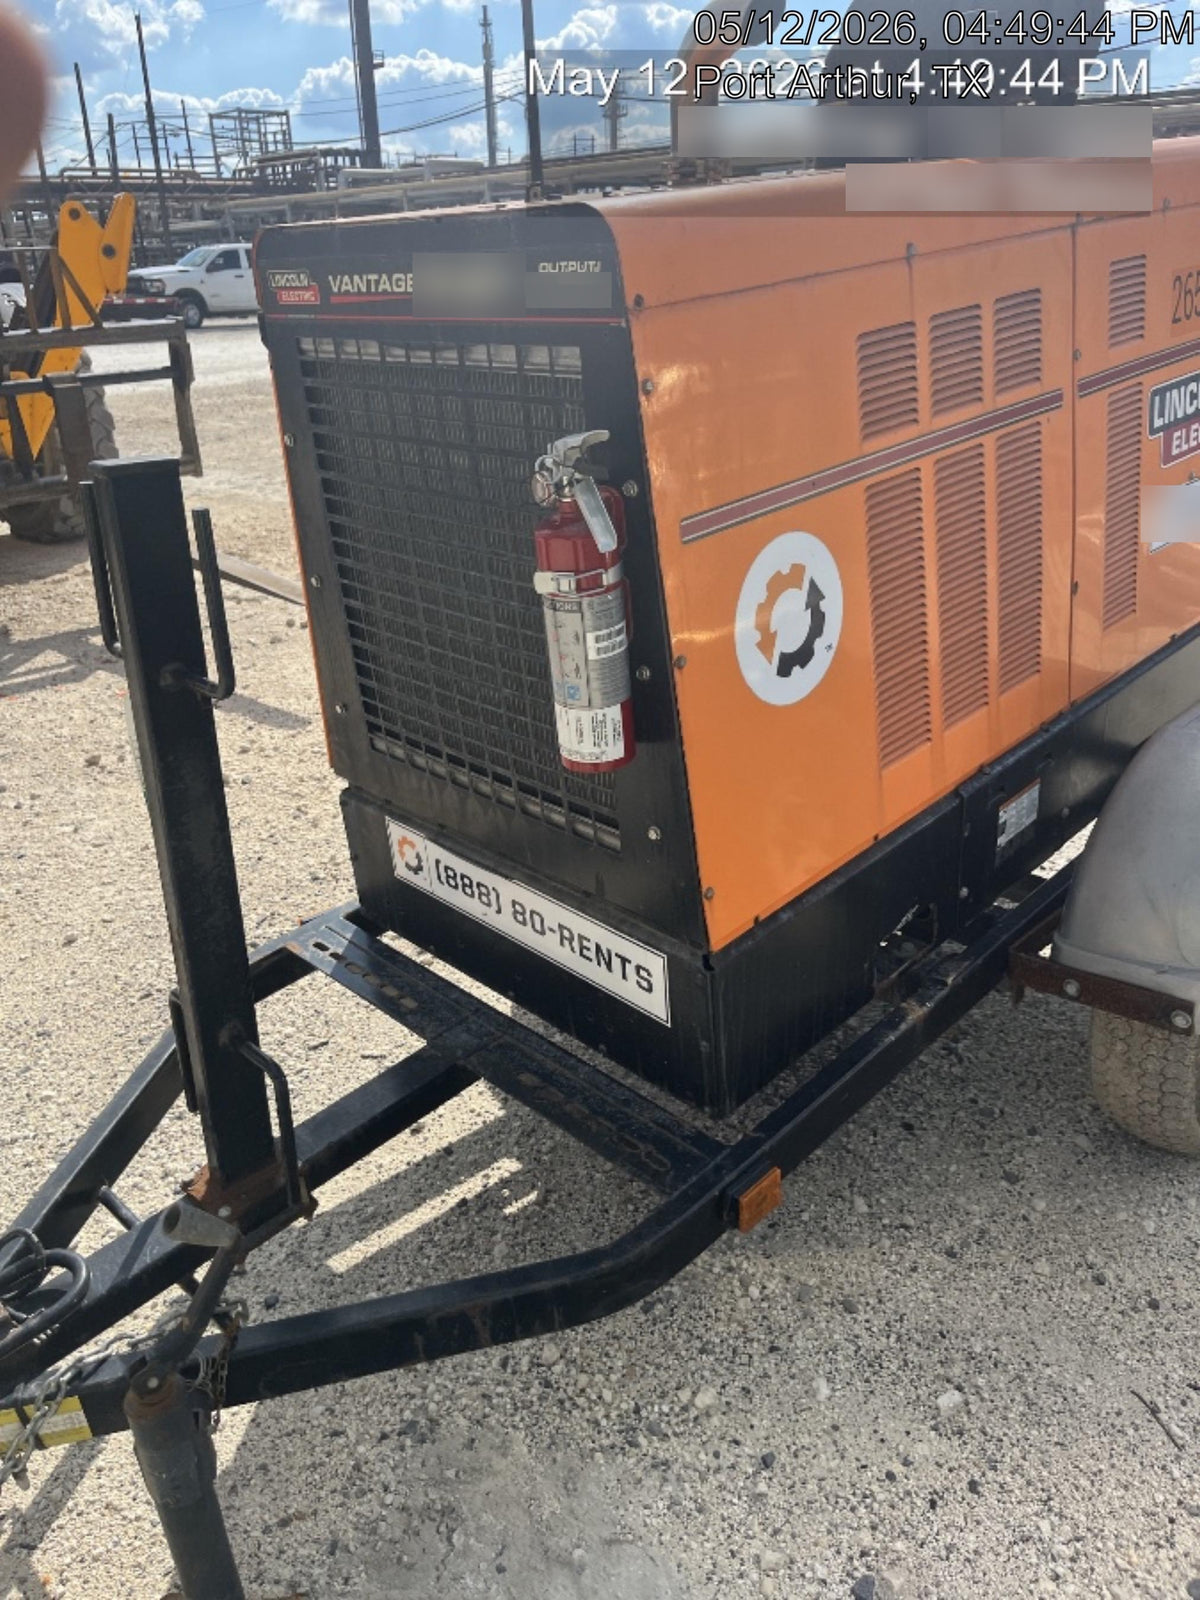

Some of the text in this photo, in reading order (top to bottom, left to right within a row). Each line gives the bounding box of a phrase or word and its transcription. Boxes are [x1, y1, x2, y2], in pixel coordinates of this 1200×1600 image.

[1153, 381, 1200, 429] LINC
[1171, 422, 1200, 456] ELE
[434, 858, 653, 994] (888) 80-RENTS
